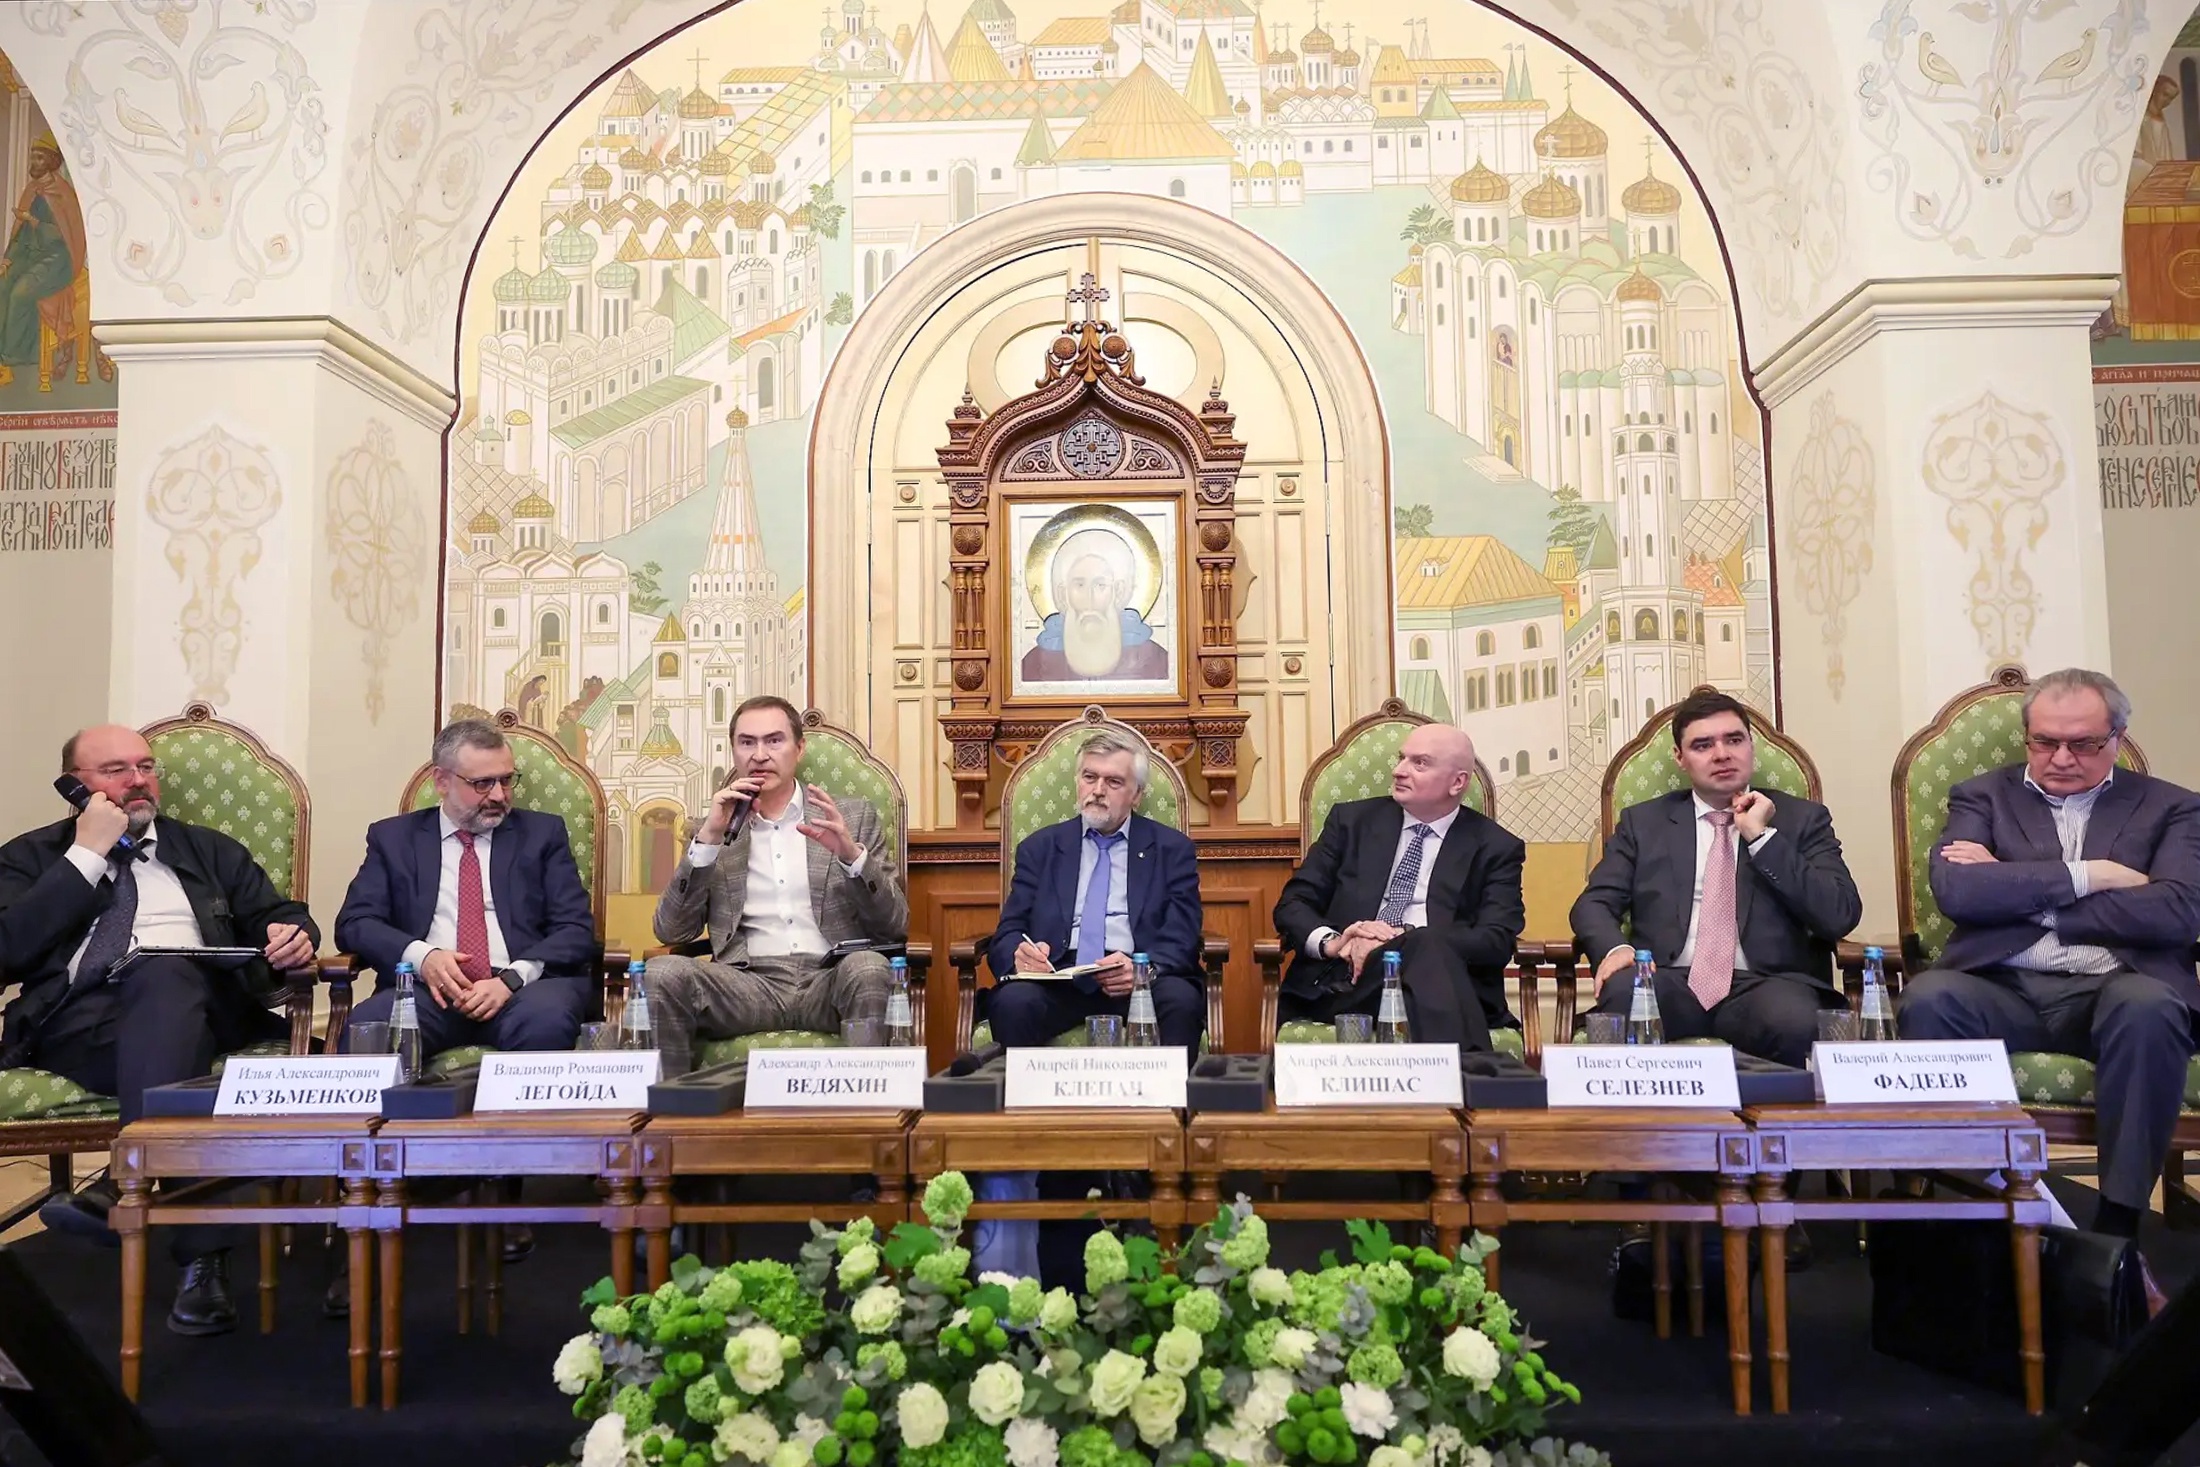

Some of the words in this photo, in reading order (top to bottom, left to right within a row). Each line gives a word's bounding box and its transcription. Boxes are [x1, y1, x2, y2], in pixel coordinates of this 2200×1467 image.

[757, 1058, 821, 1072] Александр
[824, 1058, 916, 1071] Александрович
[1025, 1057, 1080, 1074] Андрей
[1082, 1057, 1168, 1071] Николаевич
[1285, 1054, 1338, 1069] Андрей
[1342, 1054, 1450, 1069] Александрович
[1576, 1055, 1622, 1069] Павел
[1625, 1055, 1703, 1072] Сергеевич
[1832, 1051, 1889, 1067] Валерий
[1892, 1051, 1993, 1066] Александрович
[238, 1066, 272, 1080] Илья
[276, 1067, 381, 1082] Александрович
[493, 1062, 565, 1079] Владимир
[568, 1061, 644, 1075] Романович
[786, 1078, 888, 1096] ВЕДЯХИН
[1054, 1080, 1144, 1097] КЛЕПАЧ
[1320, 1076, 1422, 1093] КЛИШАС
[1585, 1079, 1705, 1096] СЕЛЕЗНЕВ
[1873, 1072, 1968, 1091] ФАДЕЕВ
[234, 1088, 378, 1105] КУЗЬМЕНКОВ
[515, 1080, 618, 1101] ЛЕГОЙДА
